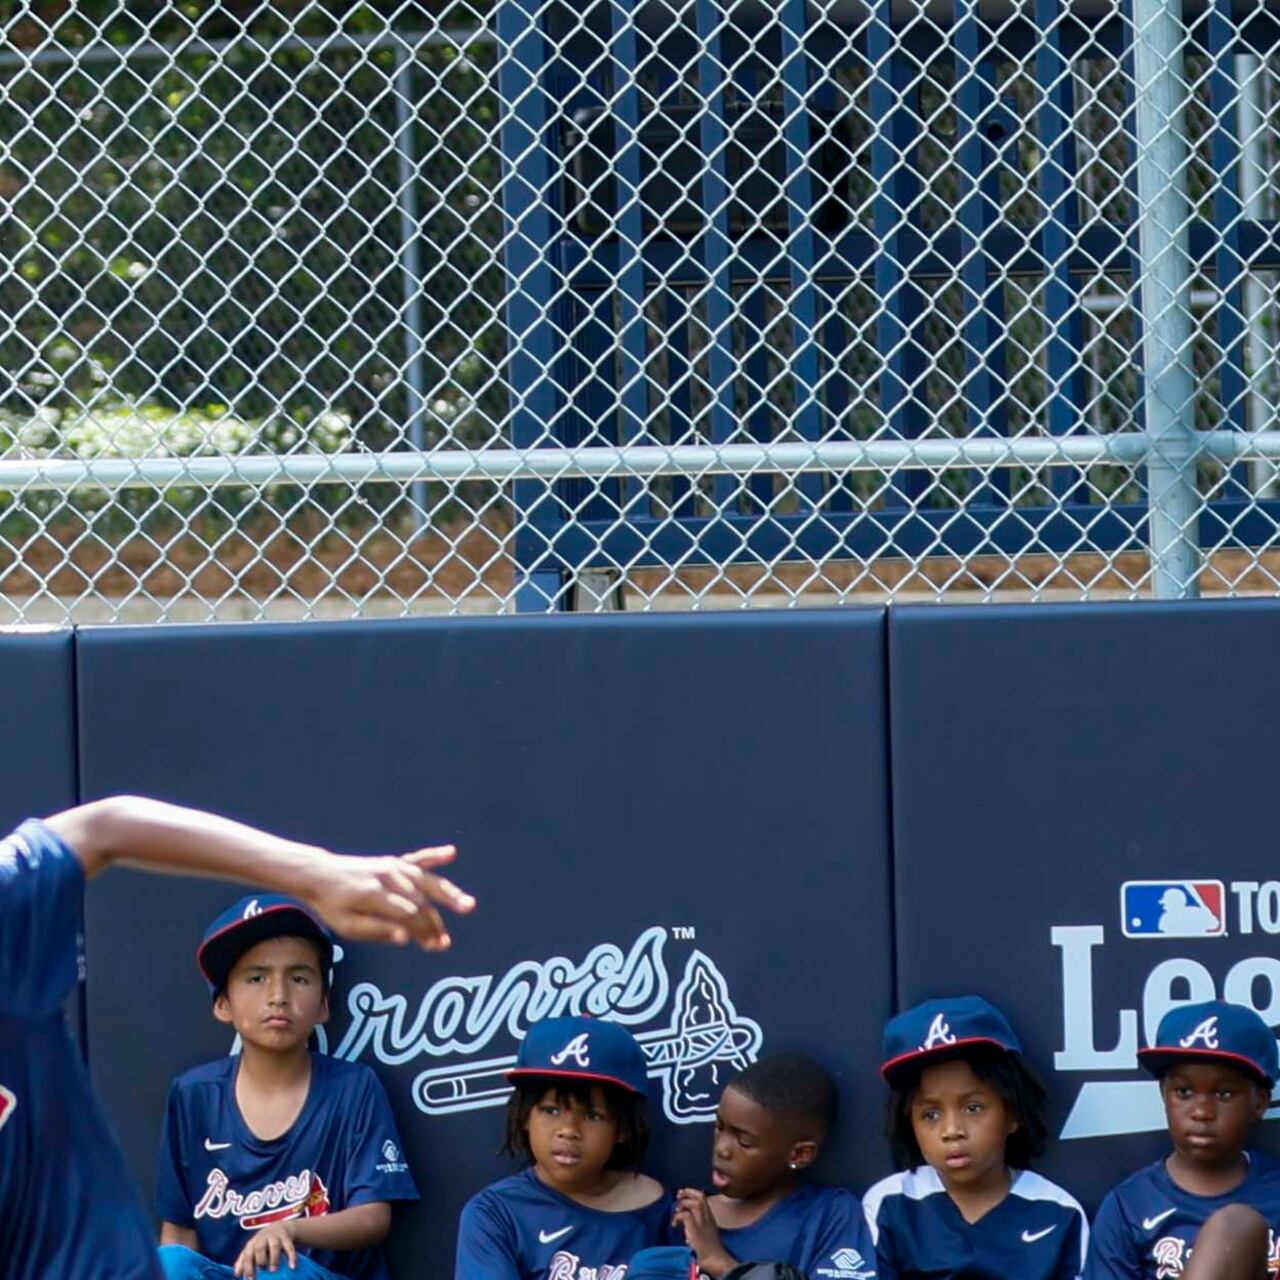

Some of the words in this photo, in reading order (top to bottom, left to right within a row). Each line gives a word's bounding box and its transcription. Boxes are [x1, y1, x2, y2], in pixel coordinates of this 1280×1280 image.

[230, 926, 668, 1065] raves
[672, 926, 696, 940] TM
[551, 1033, 590, 1068] A
[918, 1013, 957, 1053] A
[1179, 1016, 1220, 1050] A
[194, 1168, 311, 1218] Braves
